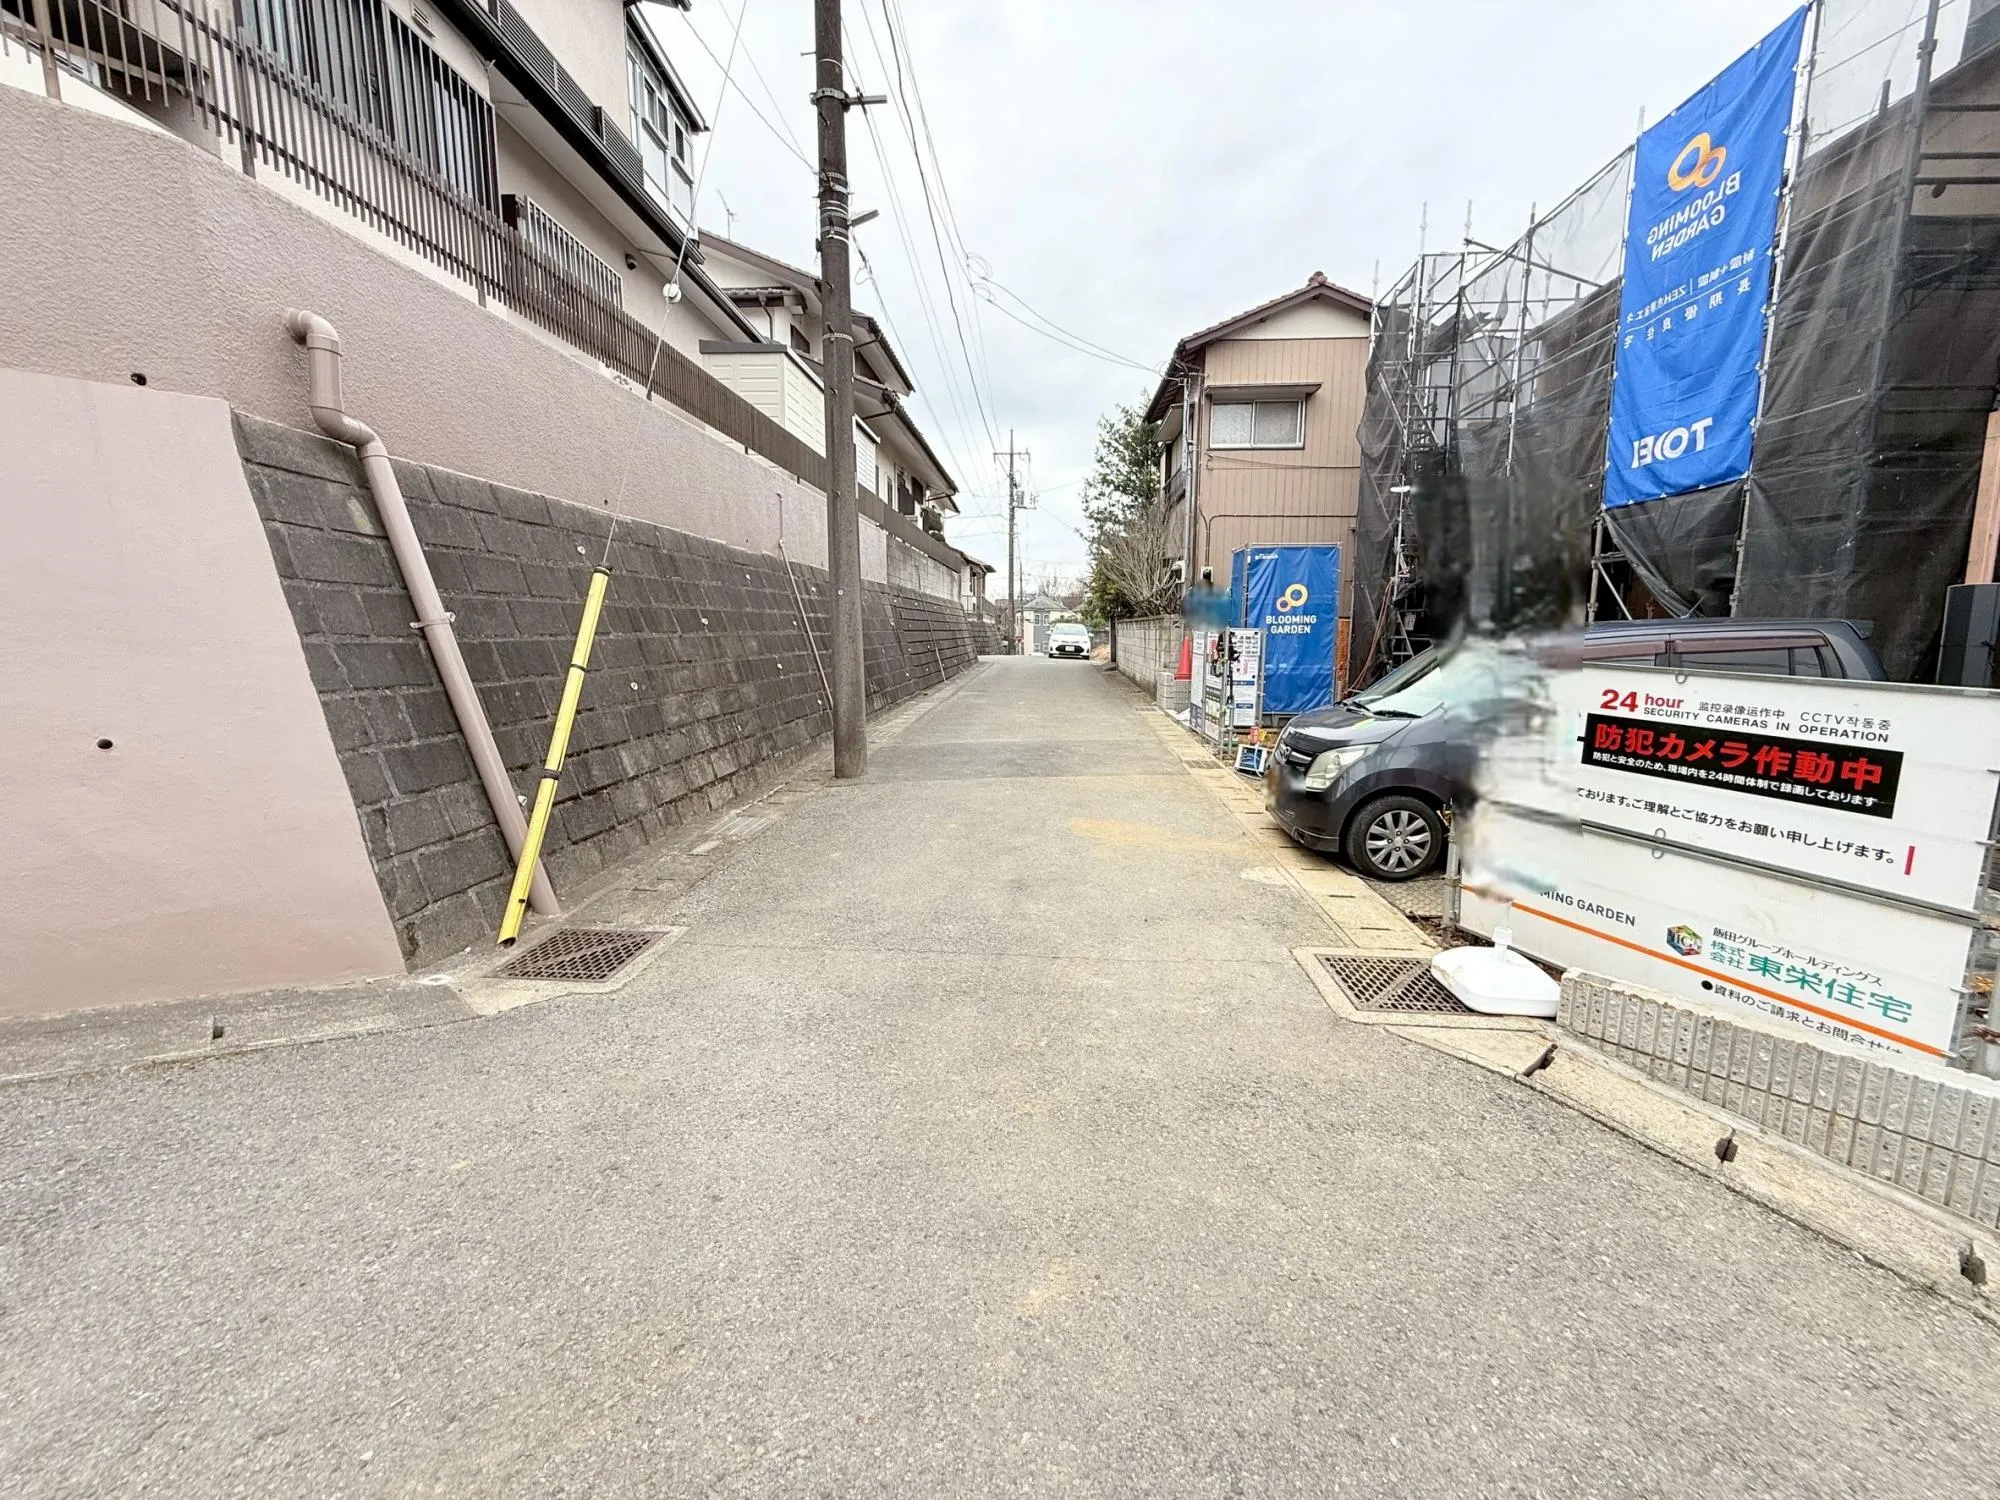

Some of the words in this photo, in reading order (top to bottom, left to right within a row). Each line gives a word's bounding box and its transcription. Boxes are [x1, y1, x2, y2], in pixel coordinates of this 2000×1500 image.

[1265, 615, 1317, 625] BLOOMING
[1270, 625, 1311, 634] GARDEN
[1600, 689, 1638, 712] 24
[1644, 693, 1684, 709] hour
[1643, 707, 1700, 720] SECURITY
[1706, 714, 1768, 729] CAMERAS
[1776, 722, 1790, 731] IN
[1799, 725, 1889, 743] OPERATION
[1594, 723, 1883, 790] 防犯カメラ作動中
[1577, 899, 1635, 927] GARDEN
[1712, 927, 1883, 986] 飯田グループホールディングス
[1747, 952, 1913, 1024] 東栄住宅
